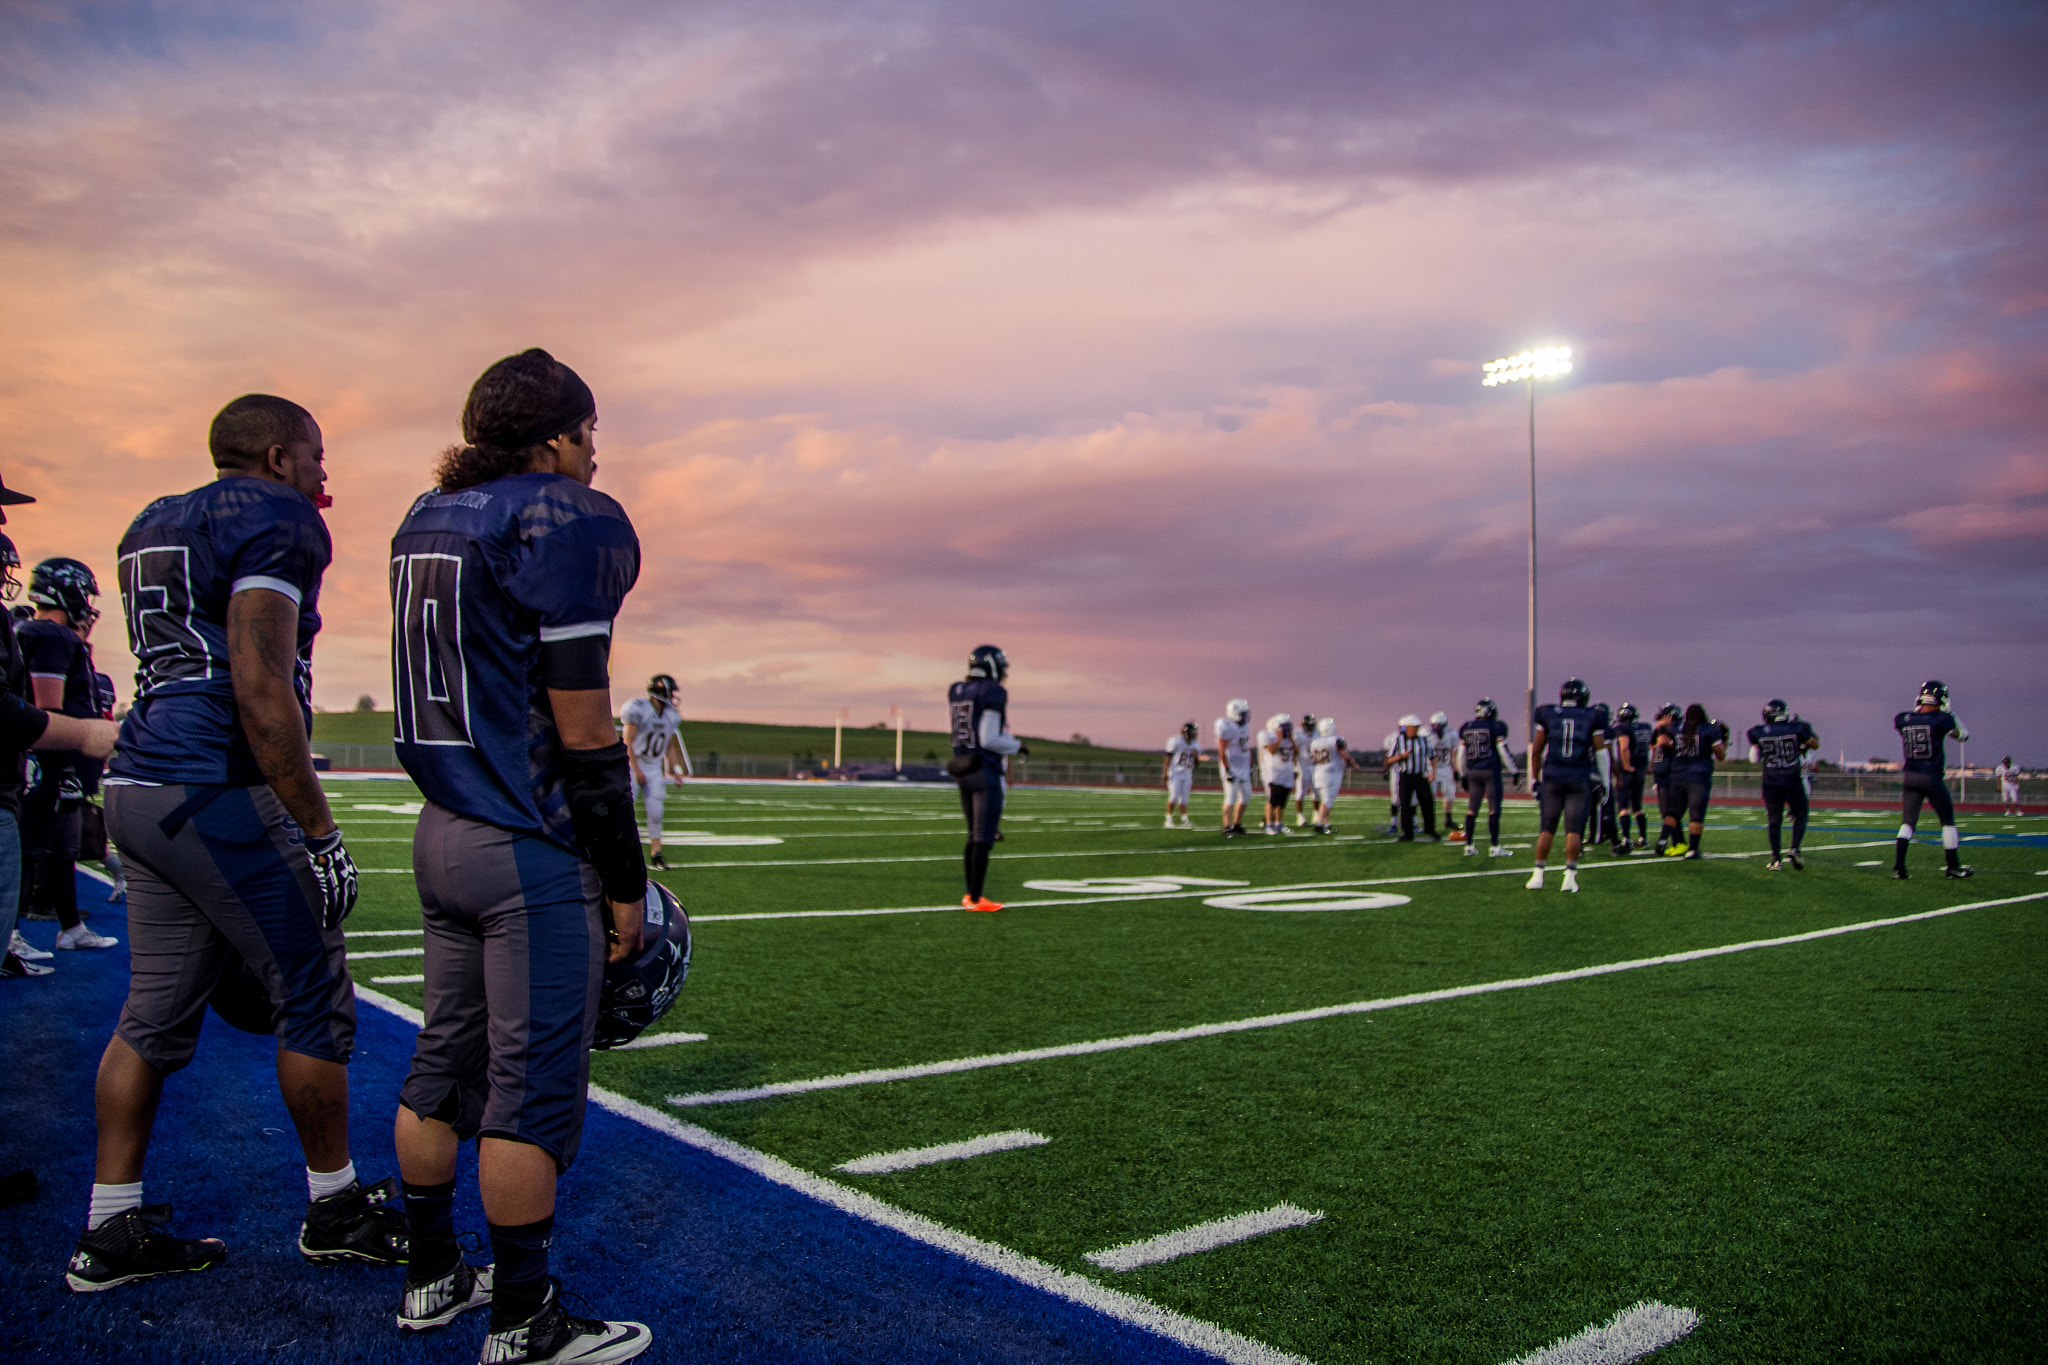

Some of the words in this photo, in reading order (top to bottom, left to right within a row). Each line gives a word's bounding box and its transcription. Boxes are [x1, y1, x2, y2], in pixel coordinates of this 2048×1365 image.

[391, 552, 475, 748] 10
[641, 730, 665, 757] 10
[1562, 719, 1574, 757] 1
[405, 1274, 455, 1320] NIKE
